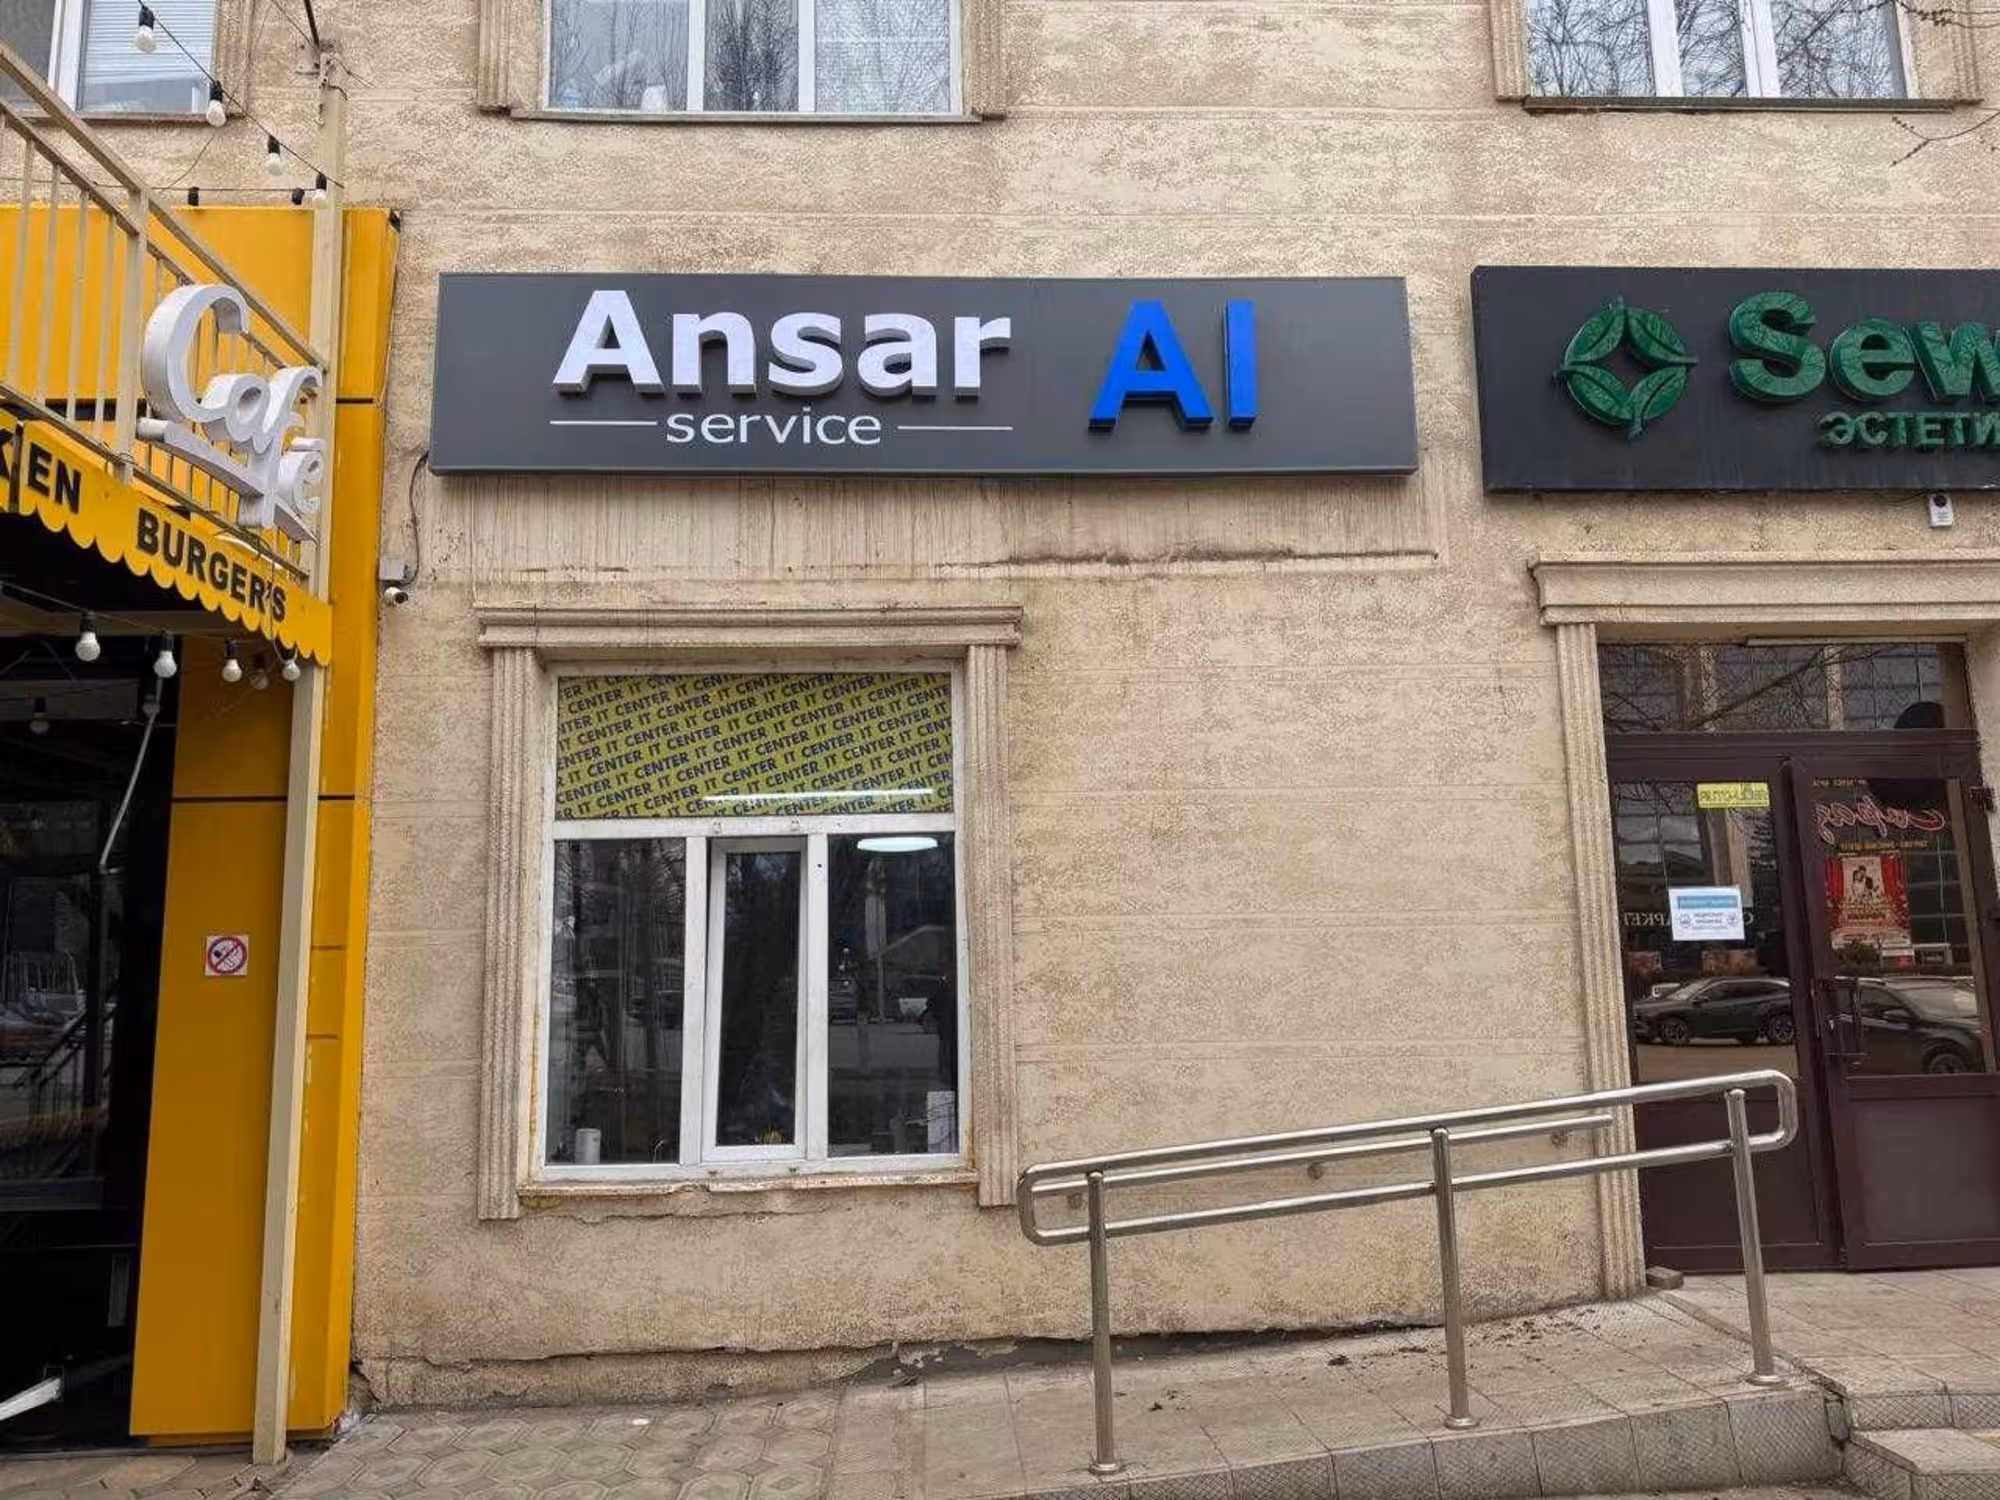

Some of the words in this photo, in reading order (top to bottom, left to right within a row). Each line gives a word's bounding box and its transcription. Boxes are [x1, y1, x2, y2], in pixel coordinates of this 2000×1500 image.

[552, 290, 1012, 396] Ansar
[1088, 299, 1258, 431] AI
[1729, 291, 2000, 400] Sew
[666, 406, 881, 445] service
[137, 507, 286, 623] BURGER'S
[560, 738, 570, 751] IT
[576, 718, 633, 746] CENTER
[639, 712, 650, 726] IT
[657, 693, 711, 720] CENTER
[717, 687, 729, 700] IT
[568, 687, 623, 715] CENTER
[629, 680, 641, 695] IT
[587, 677, 599, 691] IT
[597, 708, 608, 722] IT
[616, 690, 669, 716] CENTER
[675, 683, 687, 697] IT
[606, 740, 618, 753] IT
[625, 721, 679, 747] CENTER
[685, 715, 697, 728] IT
[704, 696, 757, 722] CENTER
[763, 689, 775, 702] IT
[781, 674, 833, 697] CENTER
[569, 769, 580, 783] IT
[587, 749, 643, 777] CENTER
[649, 743, 660, 756] IT
[667, 723, 722, 751] CENTER
[728, 717, 740, 731] IT
[746, 698, 800, 726] CENTER
[805, 692, 817, 706] IT
[823, 675, 875, 700] CENTER
[578, 801, 590, 814] IT
[597, 781, 651, 809] CENTER
[657, 775, 670, 788] IT
[676, 755, 730, 782] CENTER
[738, 748, 749, 761] IT
[755, 729, 811, 756] CENTER
[816, 723, 826, 736] IT
[832, 705, 885, 731] CENTER
[890, 699, 902, 712] IT
[616, 771, 628, 785] IT
[635, 751, 689, 779] CENTER
[695, 745, 707, 759] IT
[713, 726, 767, 753] CENTER
[773, 720, 785, 734] IT
[792, 701, 844, 728] CENTER
[851, 695, 862, 709] IT
[868, 676, 921, 703] CENTER
[626, 802, 638, 816] IT
[645, 783, 699, 810] CENTER
[705, 776, 717, 791] IT
[723, 757, 777, 785] CENTER
[784, 750, 795, 764] IT
[801, 731, 855, 758] CENTER
[861, 725, 872, 738] IT
[878, 706, 931, 733] CENTER
[935, 701, 947, 715] IT
[747, 779, 759, 793] IT
[766, 760, 819, 788] CENTER
[824, 754, 836, 767] IT
[843, 735, 895, 761] CENTER
[899, 729, 911, 743] IT
[812, 763, 865, 790] CENTER
[871, 755, 882, 770] IT
[889, 737, 940, 763] CENTER
[910, 760, 921, 774] IT
